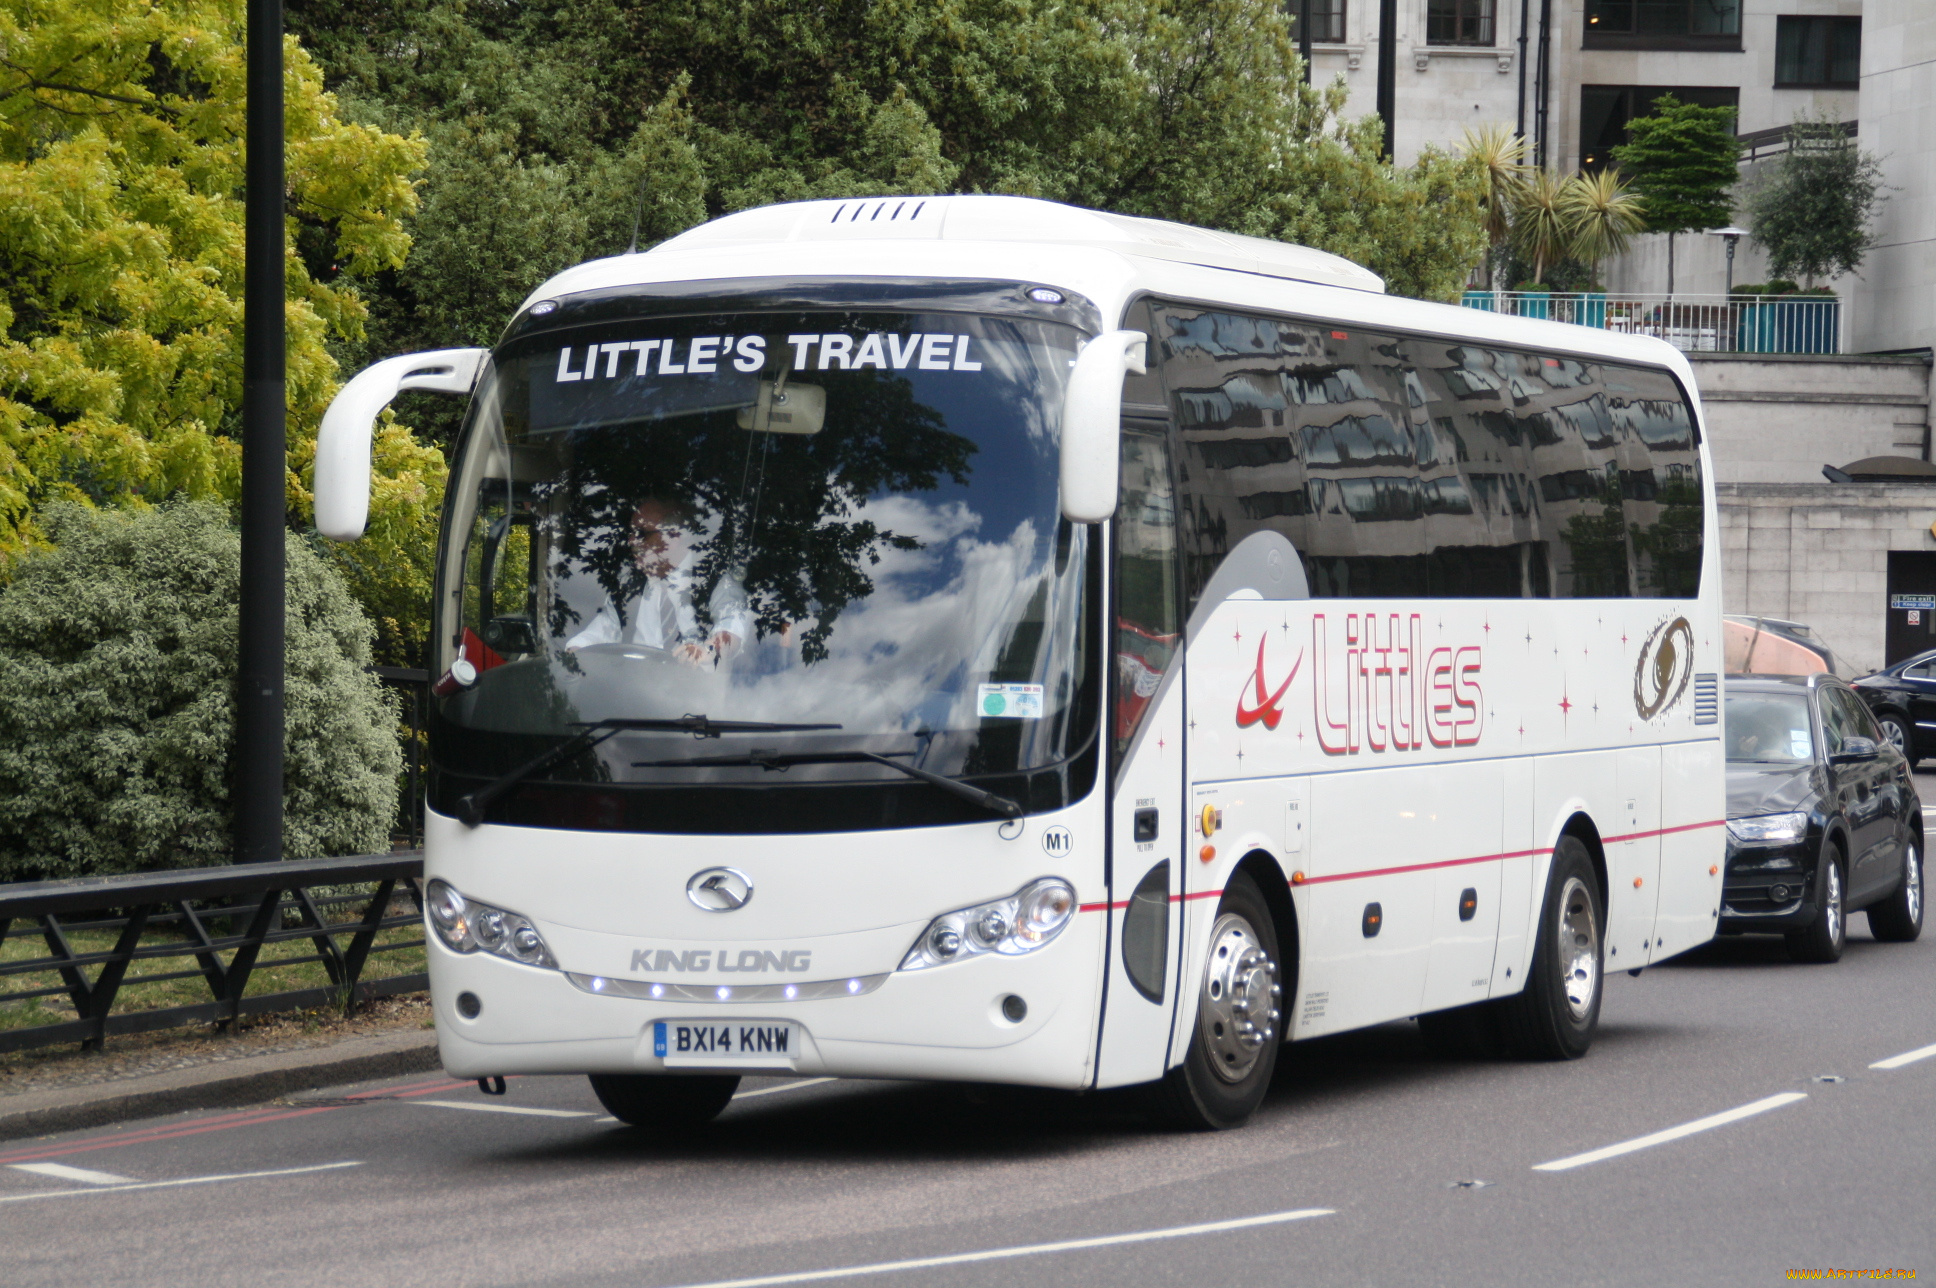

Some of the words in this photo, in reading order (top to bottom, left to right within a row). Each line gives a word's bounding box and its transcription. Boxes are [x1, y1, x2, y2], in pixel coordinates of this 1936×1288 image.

[556, 335, 766, 383] LITTLE'S
[787, 333, 982, 371] TRAVEL
[437, 672, 451, 686] COSTA
[1312, 613, 1484, 757] Littles
[1046, 833, 1069, 850] M1
[630, 949, 713, 973] KING
[717, 949, 812, 973] LONG
[676, 1026, 732, 1052] BX14
[740, 1026, 789, 1053] KNW
